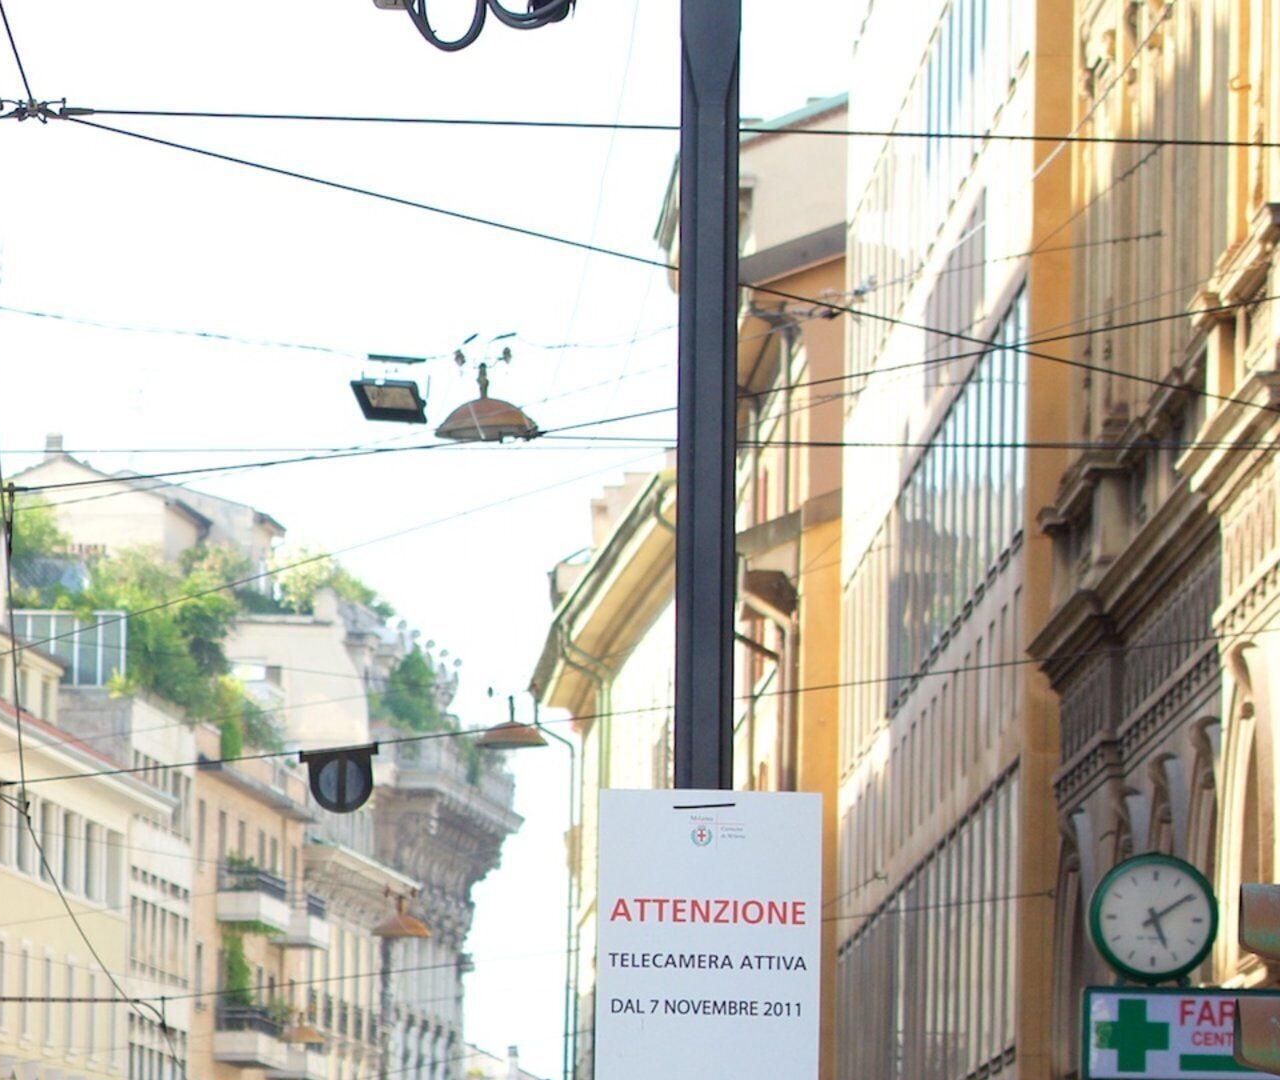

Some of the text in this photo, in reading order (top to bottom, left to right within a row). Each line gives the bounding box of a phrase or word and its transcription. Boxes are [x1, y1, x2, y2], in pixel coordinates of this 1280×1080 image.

[610, 898, 806, 925] ATTENZIONE
[609, 953, 807, 971] TELECAMERA ATTIVA
[611, 999, 801, 1017] DAL 7 NOVEMBRE 2011
